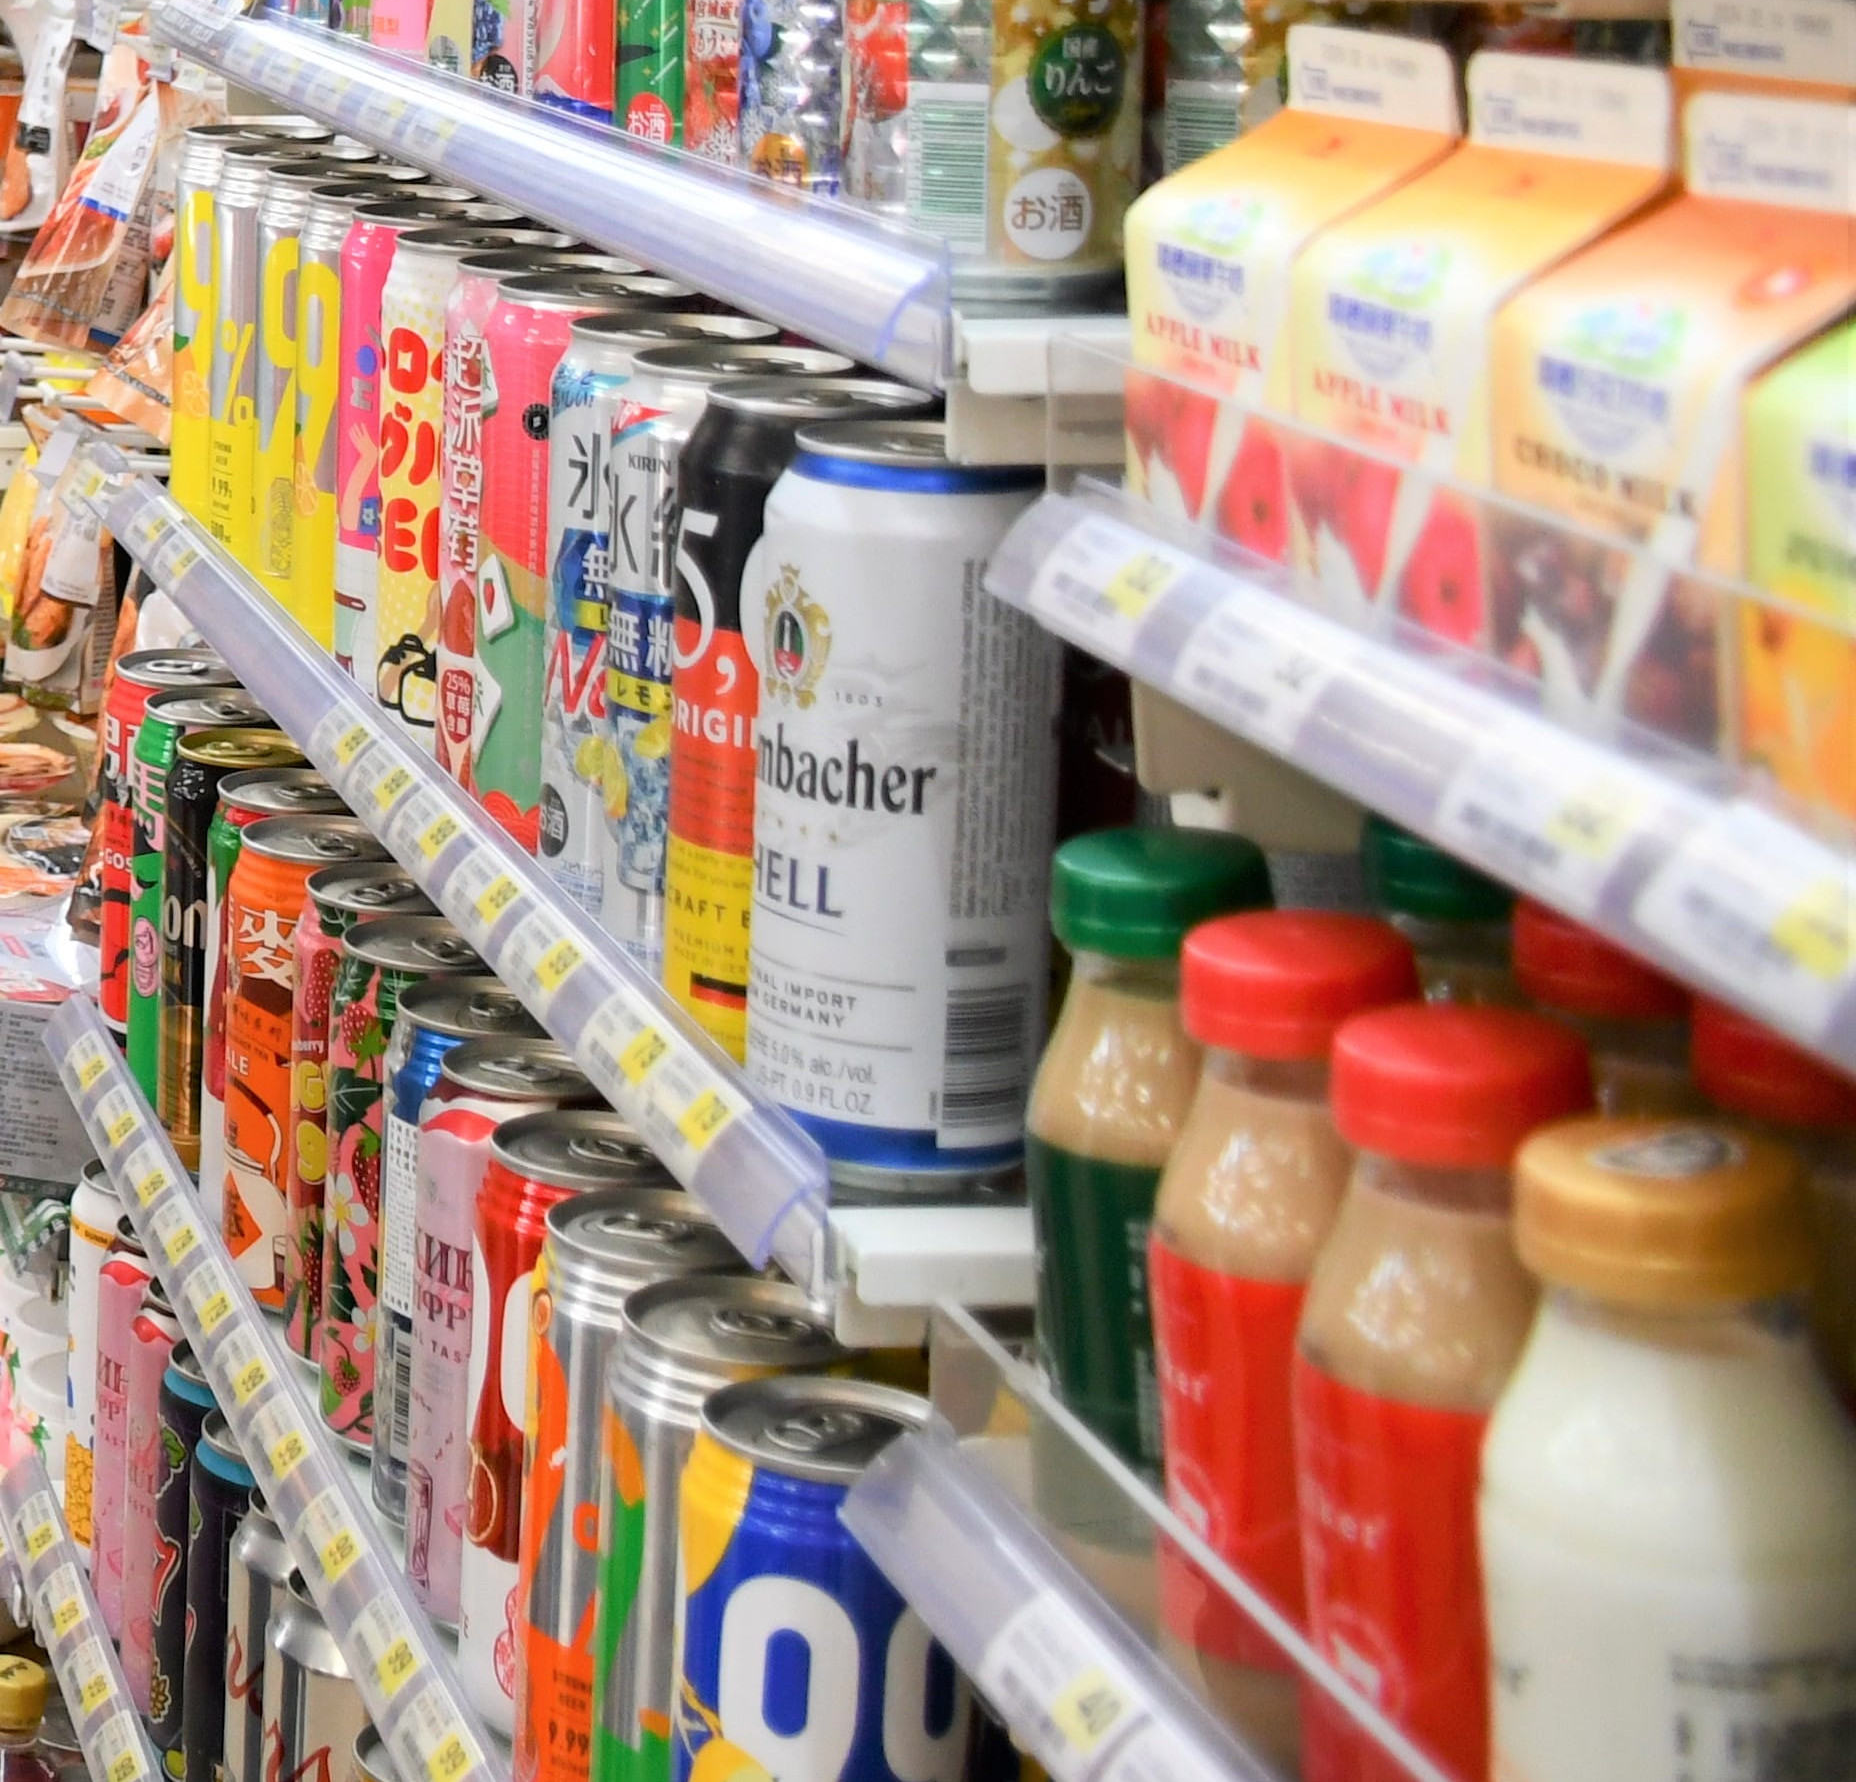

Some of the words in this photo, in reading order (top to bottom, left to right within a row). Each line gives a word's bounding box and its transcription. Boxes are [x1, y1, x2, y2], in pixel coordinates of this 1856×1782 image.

[1044, 62, 1117, 97] りんご
[1010, 195, 1085, 233] お酒
[1144, 311, 1202, 355] APPLE
[1209, 334, 1263, 373] MILK
[1312, 368, 1381, 414] APPLE
[627, 452, 672, 476] KIRIN
[444, 672, 472, 692] 25%
[763, 991, 846, 1030] GERMANY
[784, 982, 859, 1012] IMPORT
